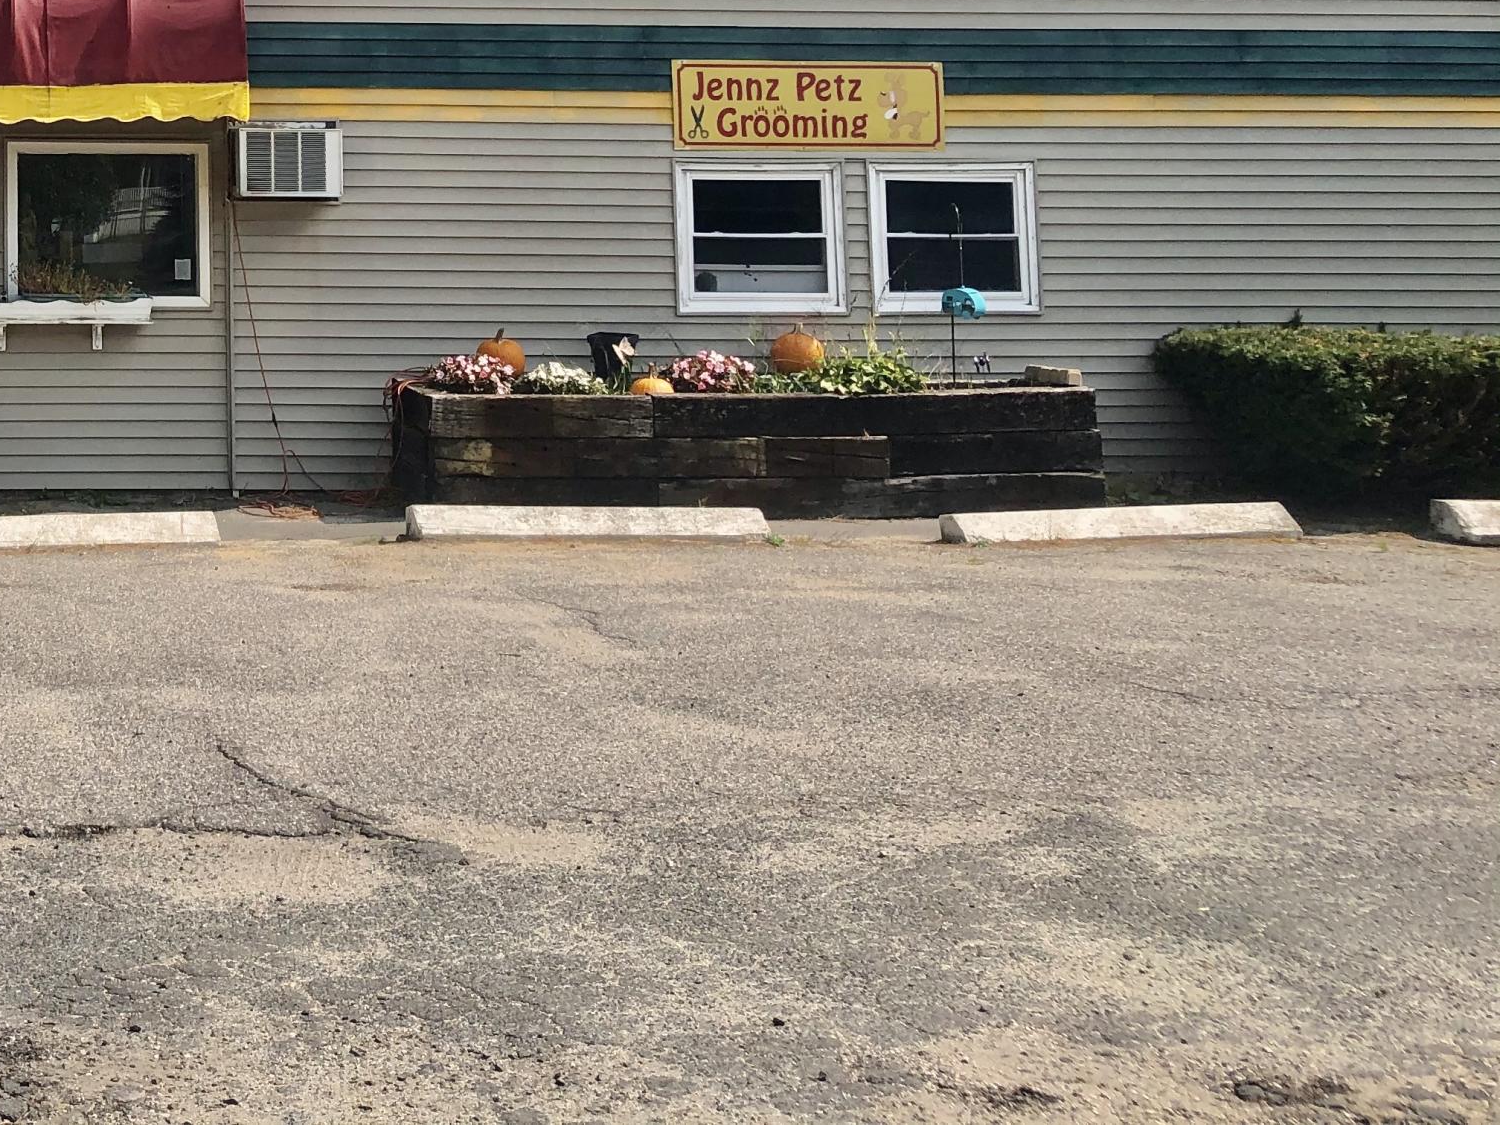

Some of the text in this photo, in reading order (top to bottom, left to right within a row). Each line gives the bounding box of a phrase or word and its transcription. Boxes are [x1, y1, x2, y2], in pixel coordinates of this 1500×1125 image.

[692, 71, 863, 102] Jennz Petz
[716, 106, 869, 139] Grooming
